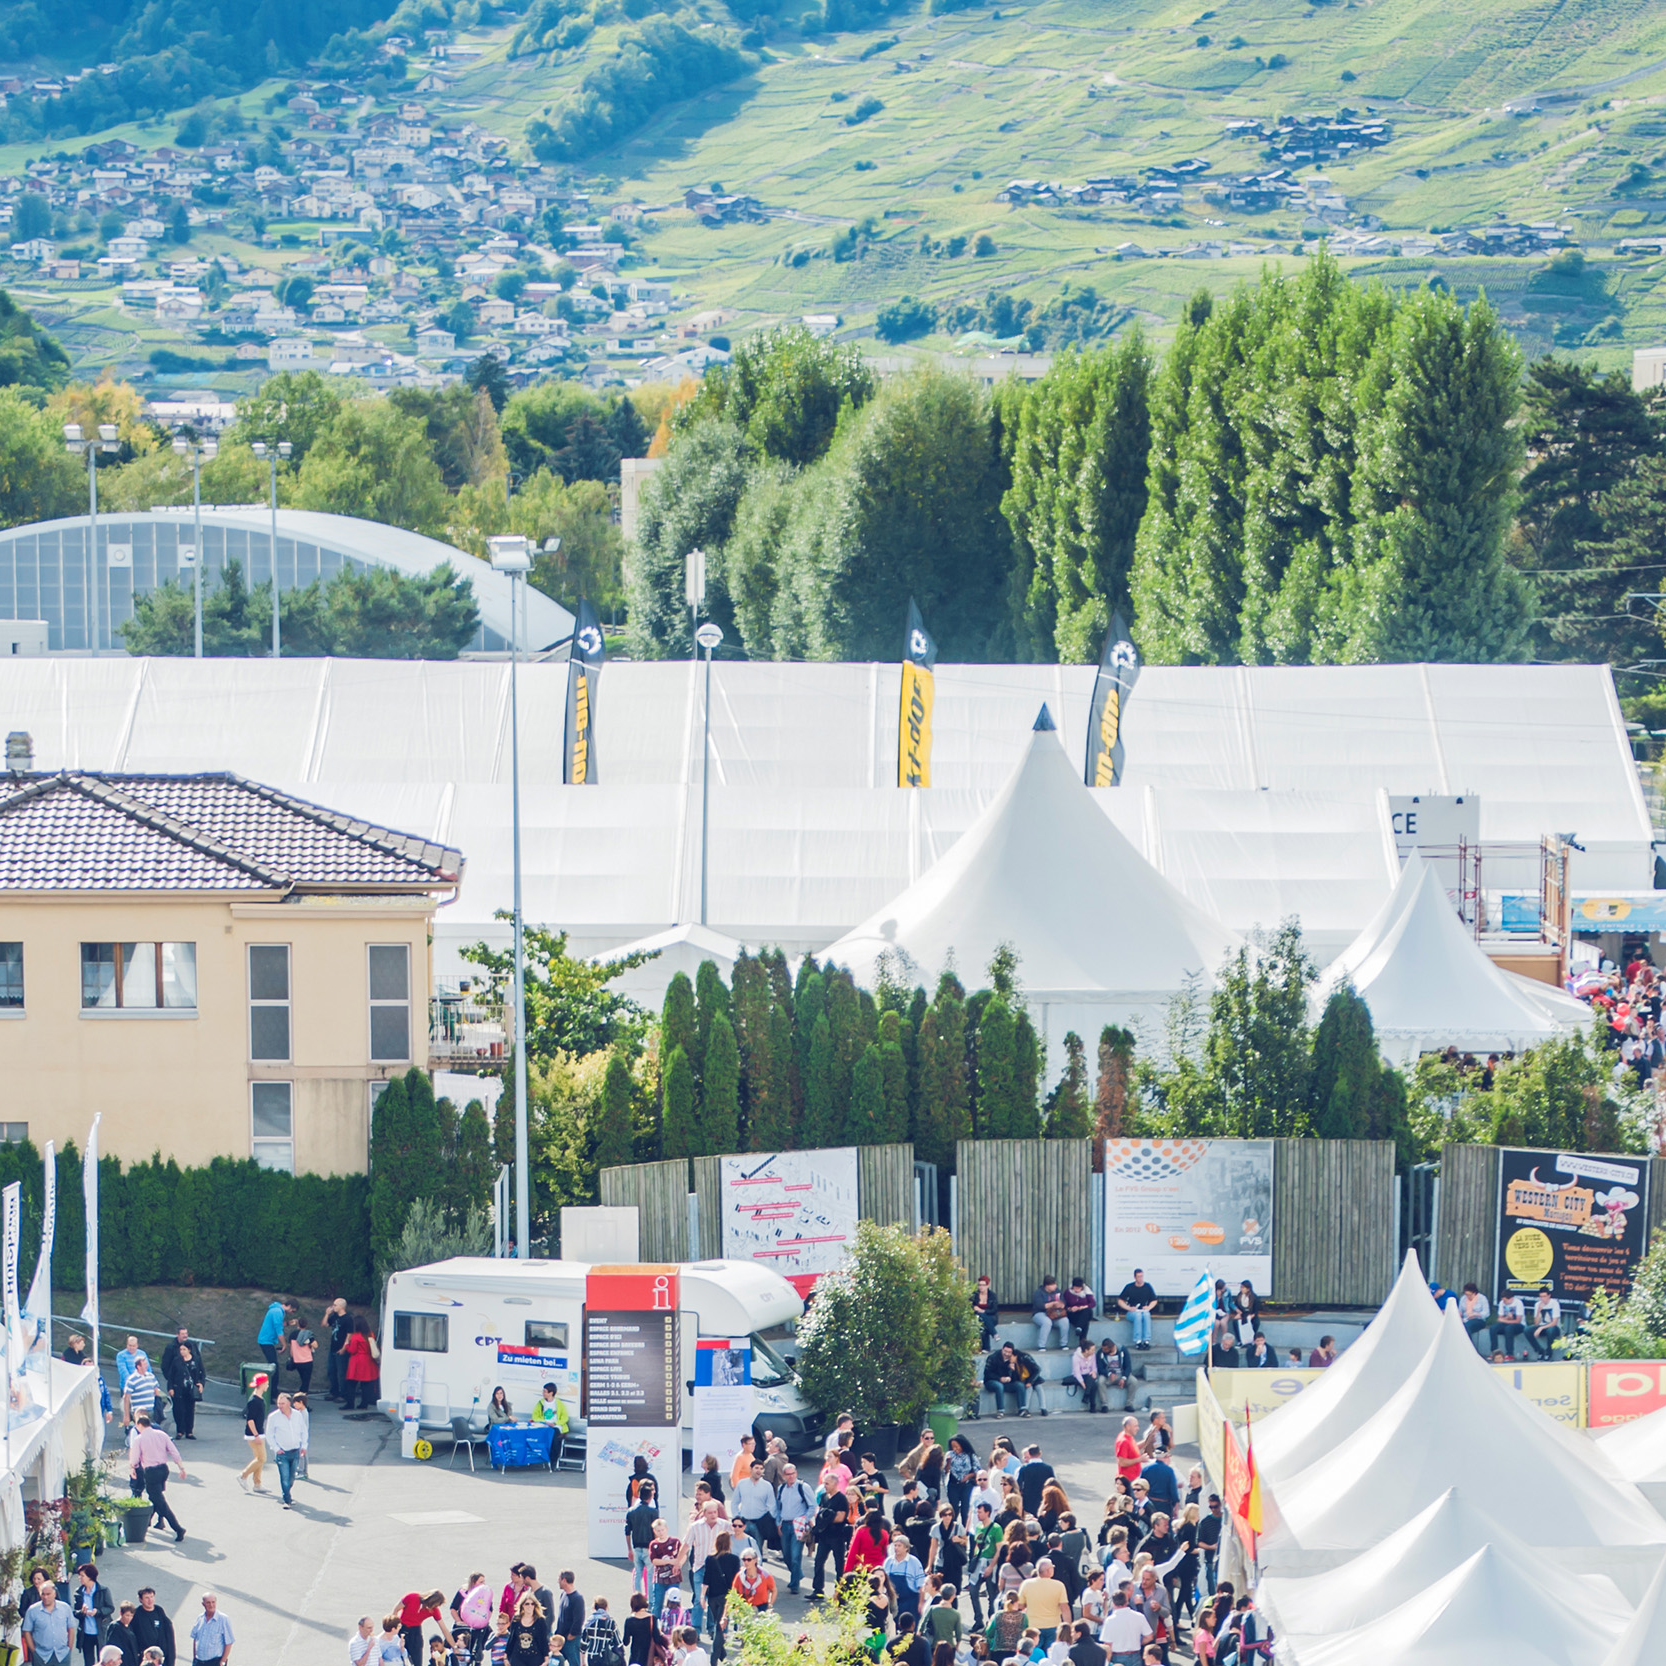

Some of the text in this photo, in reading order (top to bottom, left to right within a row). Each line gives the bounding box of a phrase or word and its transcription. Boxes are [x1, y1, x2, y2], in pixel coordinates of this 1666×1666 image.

[1514, 1189, 1587, 1212] WESTERN CITY
[502, 1354, 513, 1362] Zu
[514, 1355, 542, 1366] mieten
